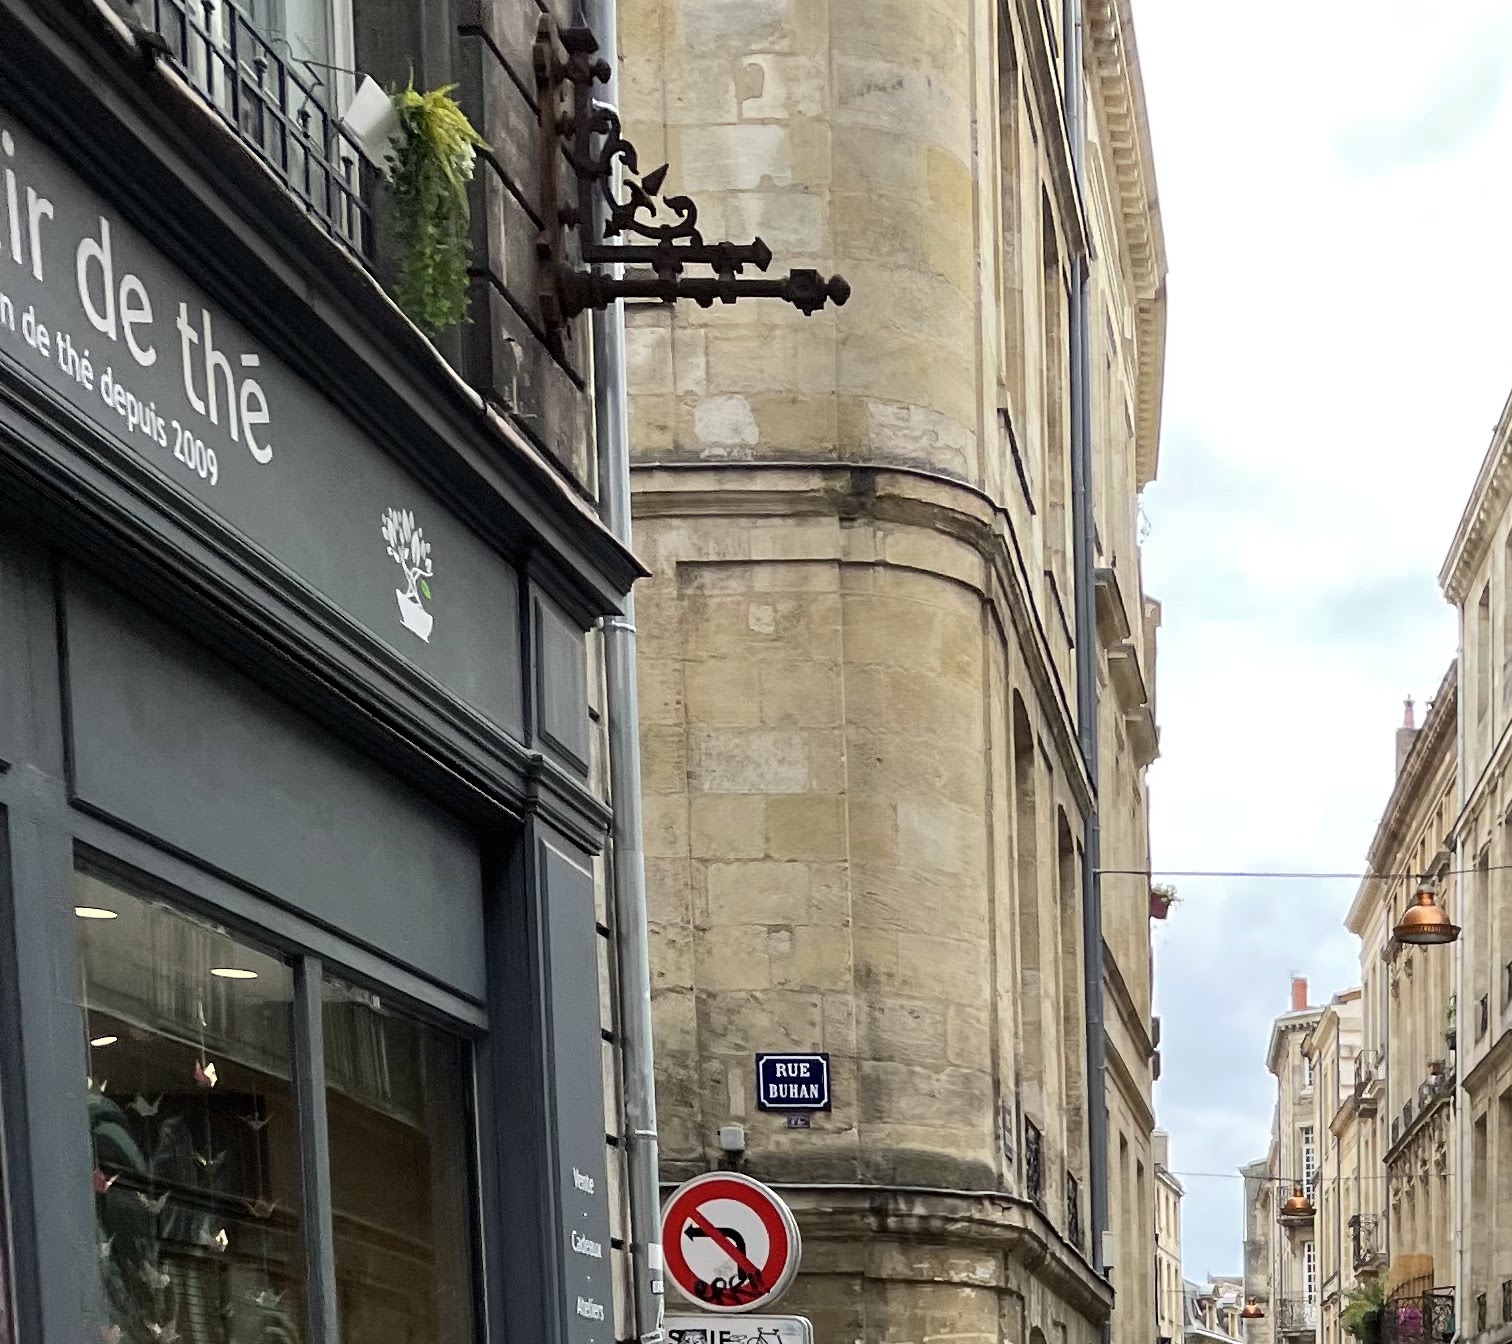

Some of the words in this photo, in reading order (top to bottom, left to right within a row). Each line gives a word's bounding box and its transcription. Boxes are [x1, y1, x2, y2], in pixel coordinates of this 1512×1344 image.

[0, 129, 54, 282] ir
[76, 216, 157, 367] de
[176, 302, 273, 464] thé
[22, 305, 50, 358] de
[56, 331, 94, 391] thé
[100, 366, 168, 448] depuis
[171, 419, 218, 486] 2009
[769, 1083, 819, 1098] BUHAN
[776, 1063, 810, 1077] RUE
